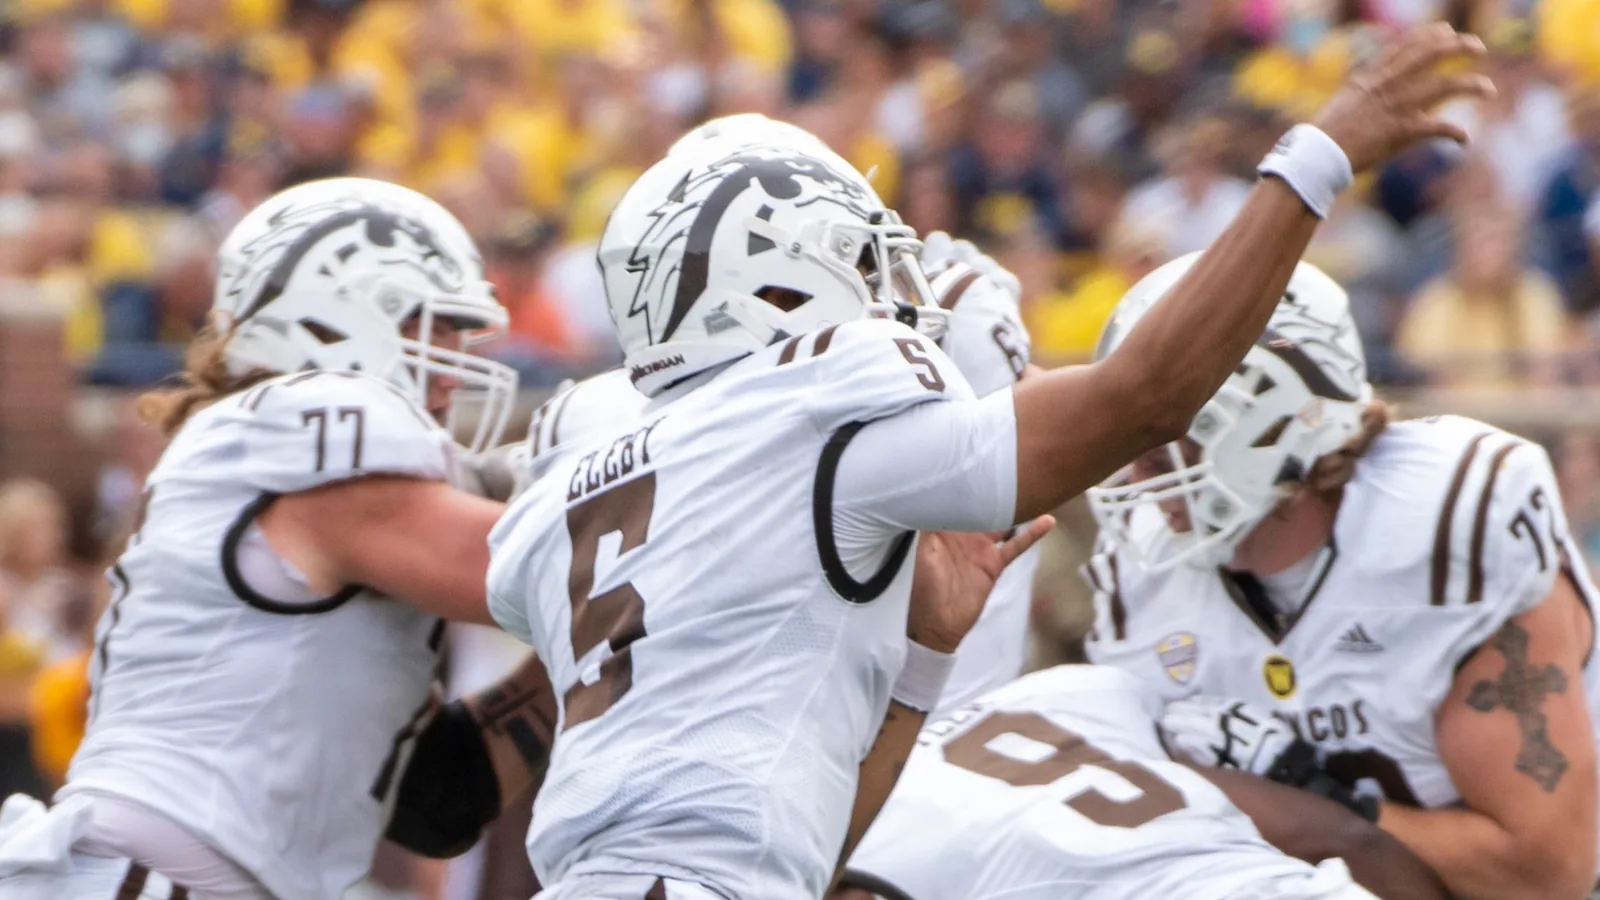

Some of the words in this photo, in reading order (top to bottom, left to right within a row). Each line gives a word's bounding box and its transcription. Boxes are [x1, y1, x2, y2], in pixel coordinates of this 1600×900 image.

[892, 338, 946, 393] 5
[990, 313, 1031, 382] 6
[302, 405, 364, 472] 77
[561, 470, 656, 735] 5
[942, 709, 1190, 830] 9
